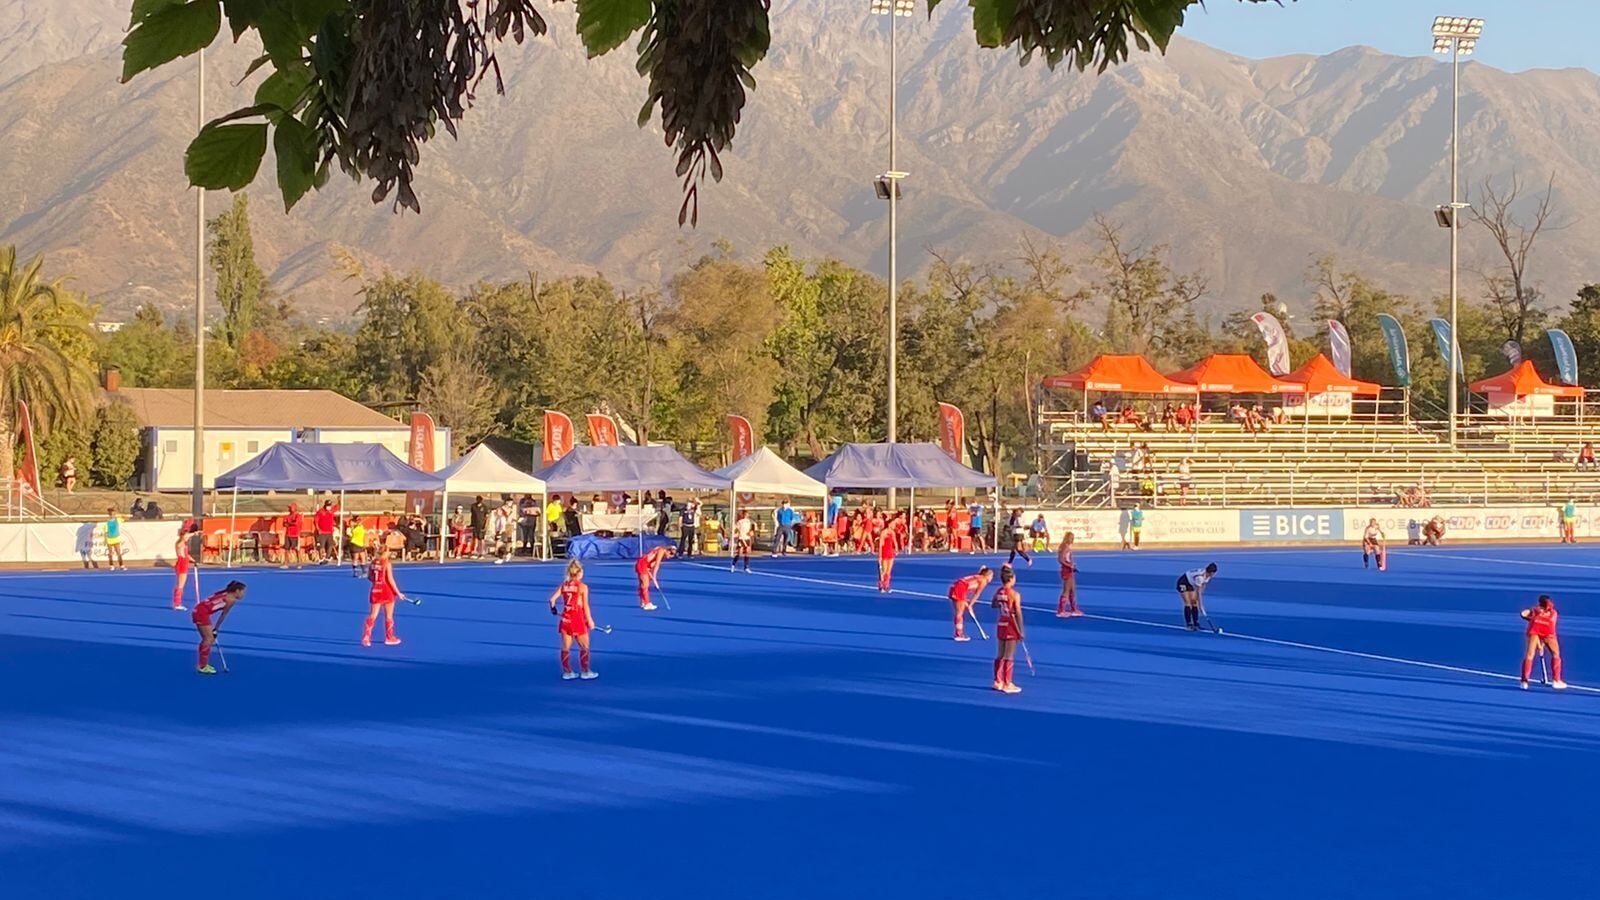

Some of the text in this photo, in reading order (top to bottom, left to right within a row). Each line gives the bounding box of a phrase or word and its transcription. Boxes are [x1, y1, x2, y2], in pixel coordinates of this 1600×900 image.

[1276, 515, 1330, 536] BICE
[1352, 518, 1395, 530] BACO
[1169, 526, 1226, 535] COUNTRY CLUB
